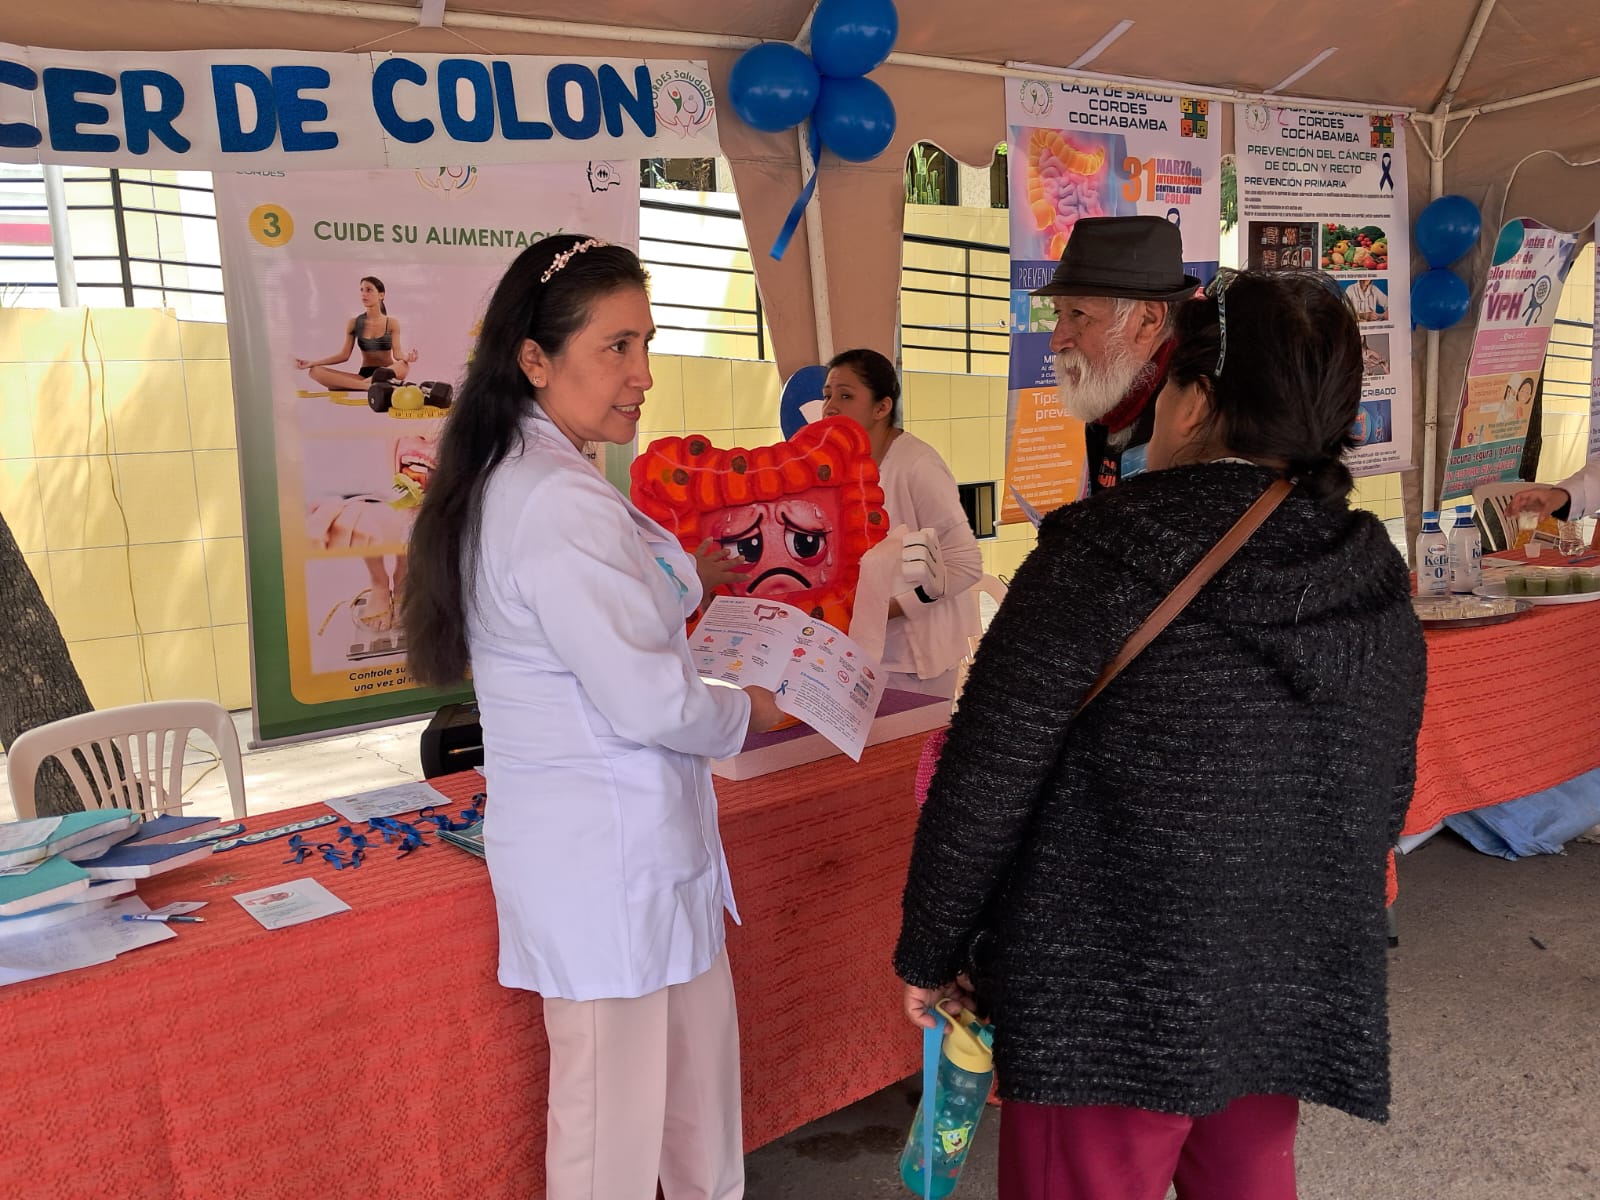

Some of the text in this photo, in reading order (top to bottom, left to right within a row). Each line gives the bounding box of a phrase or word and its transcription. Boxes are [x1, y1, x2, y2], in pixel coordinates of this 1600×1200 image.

[674, 69, 713, 107] Saludable
[211, 64, 339, 153] DE
[372, 57, 658, 144] COLON
[1089, 99, 1148, 115] CORDES
[1069, 111, 1168, 131] COCHABAMBA
[1298, 116, 1345, 129] CORDES
[1281, 128, 1360, 143] COCHABAMBA
[1247, 144, 1377, 161] PREVENCIÓN DEL CÁNCER
[1264, 161, 1362, 174] DE COLON Y RECTO
[1122, 156, 1156, 203] 31
[1156, 158, 1192, 176] MARZO
[1156, 174, 1202, 187] INTERNACIONAL
[1244, 176, 1347, 188] PREVENCIÓN PRIMARIA
[263, 212, 281, 238] 3
[314, 220, 385, 242] CUIDE
[391, 224, 418, 244] SU
[1523, 252, 1534, 264] de
[1505, 267, 1537, 280] uterino
[1485, 291, 1525, 321] VPH
[1032, 392, 1058, 406] Tips
[349, 668, 393, 681] Controle
[354, 683, 373, 692] una
[377, 678, 393, 687] vez
[397, 676, 406, 685] al
